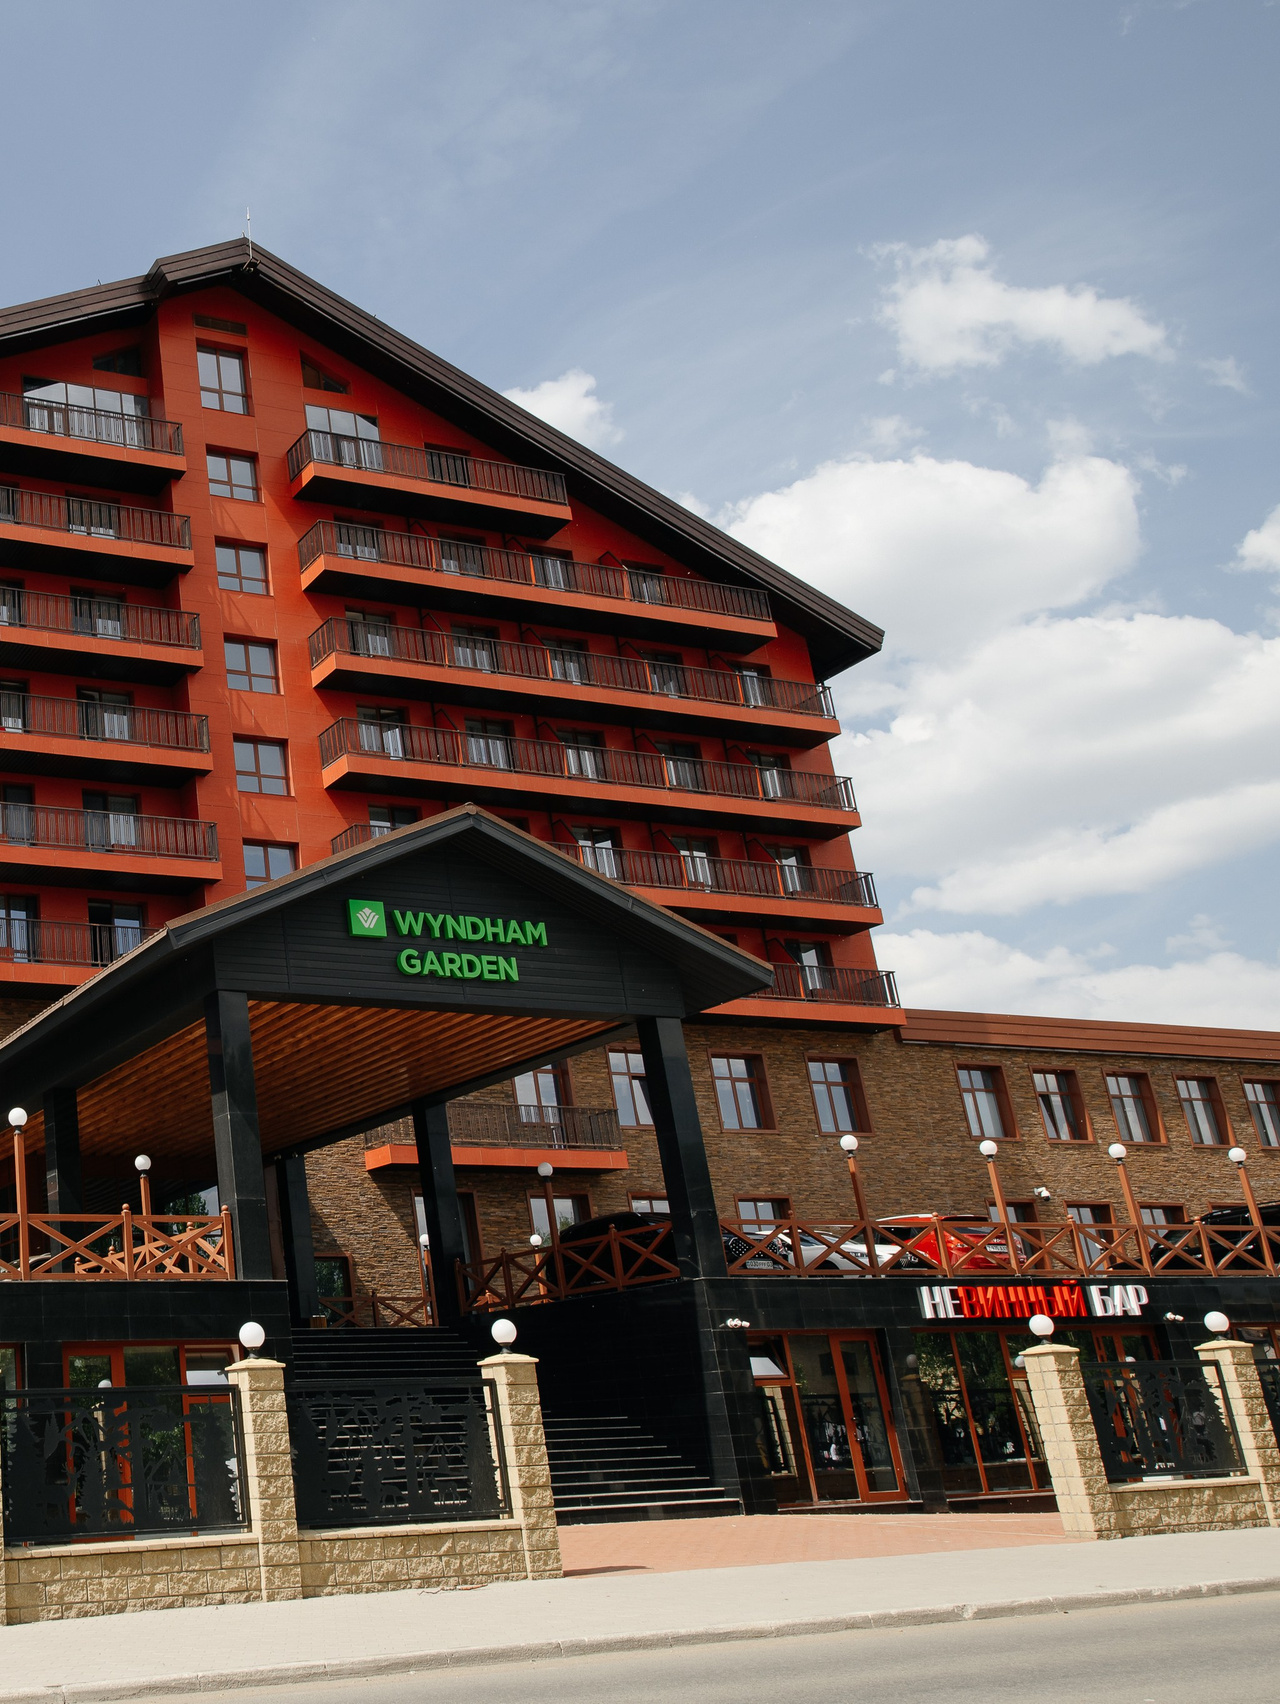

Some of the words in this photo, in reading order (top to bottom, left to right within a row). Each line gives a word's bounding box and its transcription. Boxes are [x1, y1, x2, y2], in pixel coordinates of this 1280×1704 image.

[392, 910, 548, 947] WYNDHAM
[396, 948, 519, 982] GARDEN
[917, 1279, 1088, 1319] НЕВИННЫЙ
[1087, 1285, 1149, 1317] БАР
